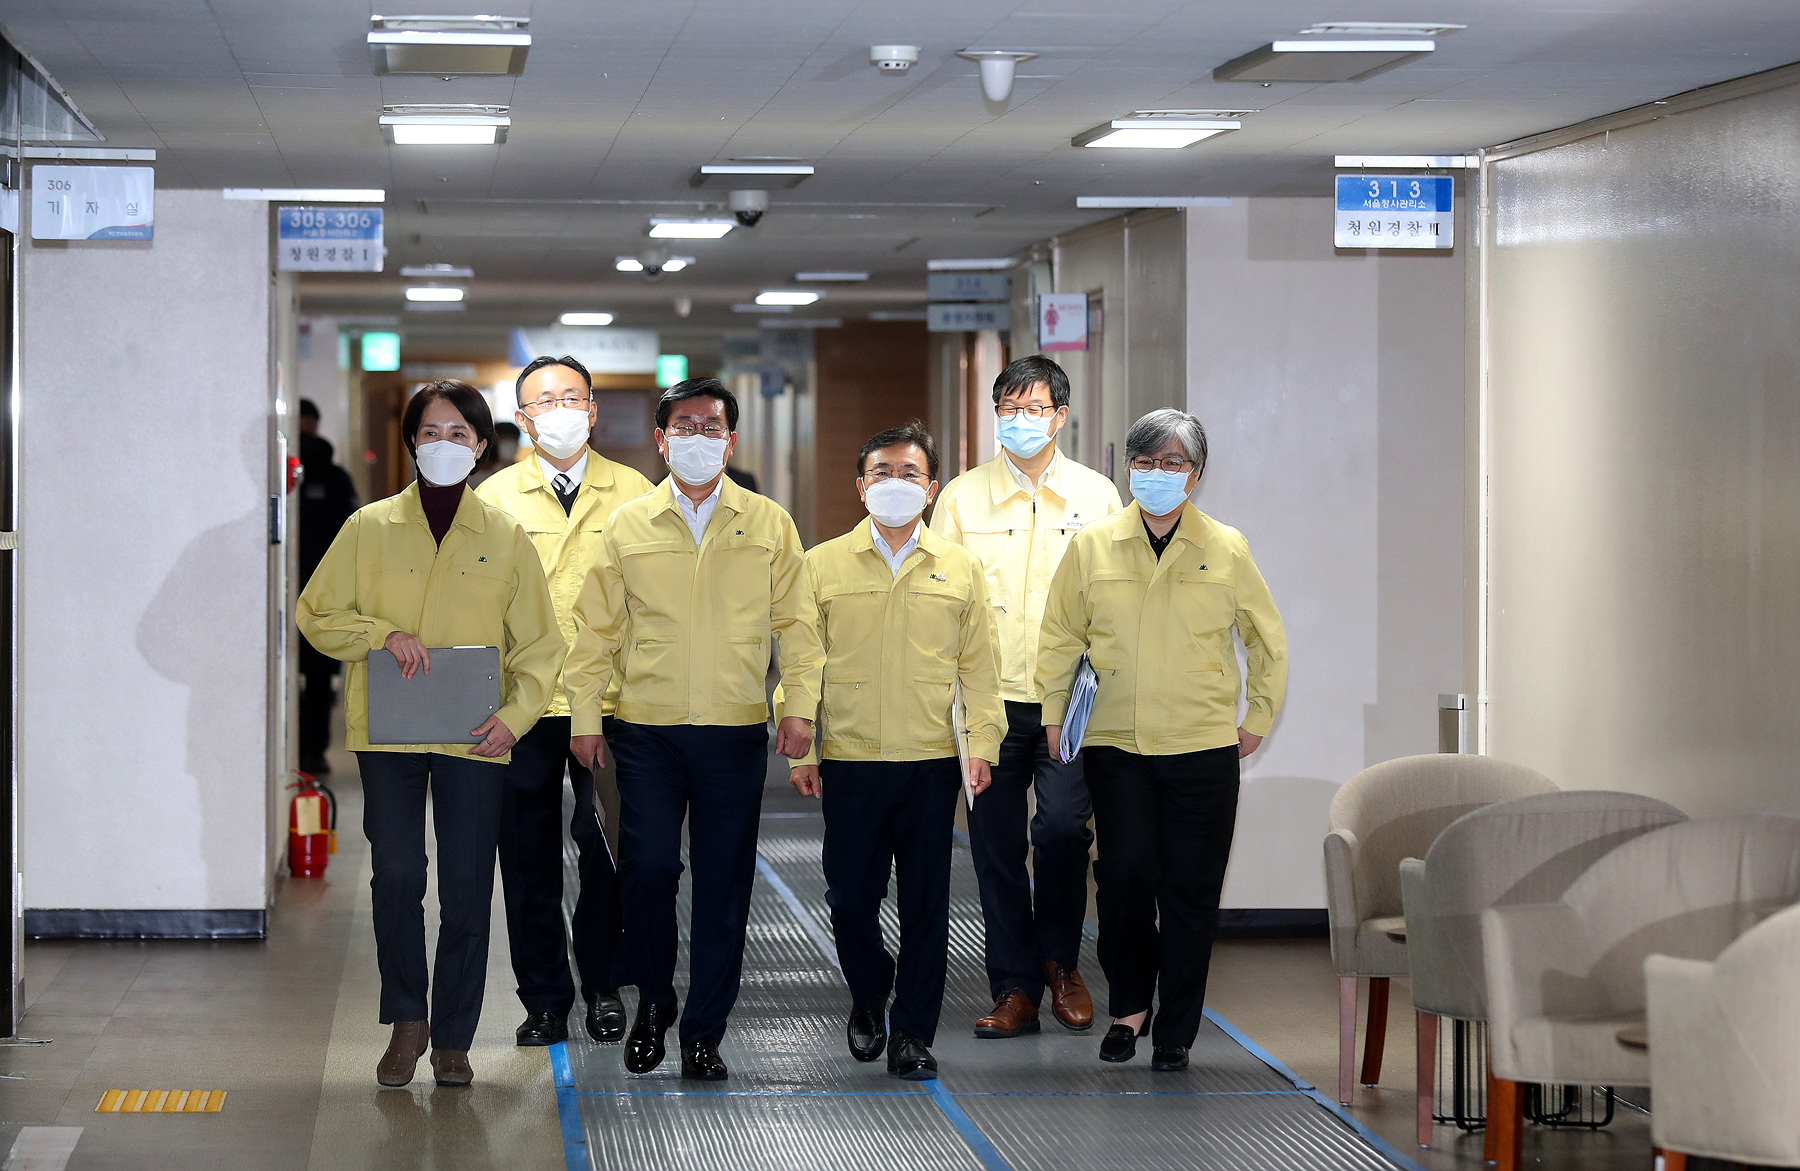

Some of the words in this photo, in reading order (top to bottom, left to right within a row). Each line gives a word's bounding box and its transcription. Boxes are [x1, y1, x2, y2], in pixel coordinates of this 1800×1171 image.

[47, 180, 72, 191] 306
[1368, 180, 1421, 198] 313
[1363, 199, 1426, 209] 서울청사관리소
